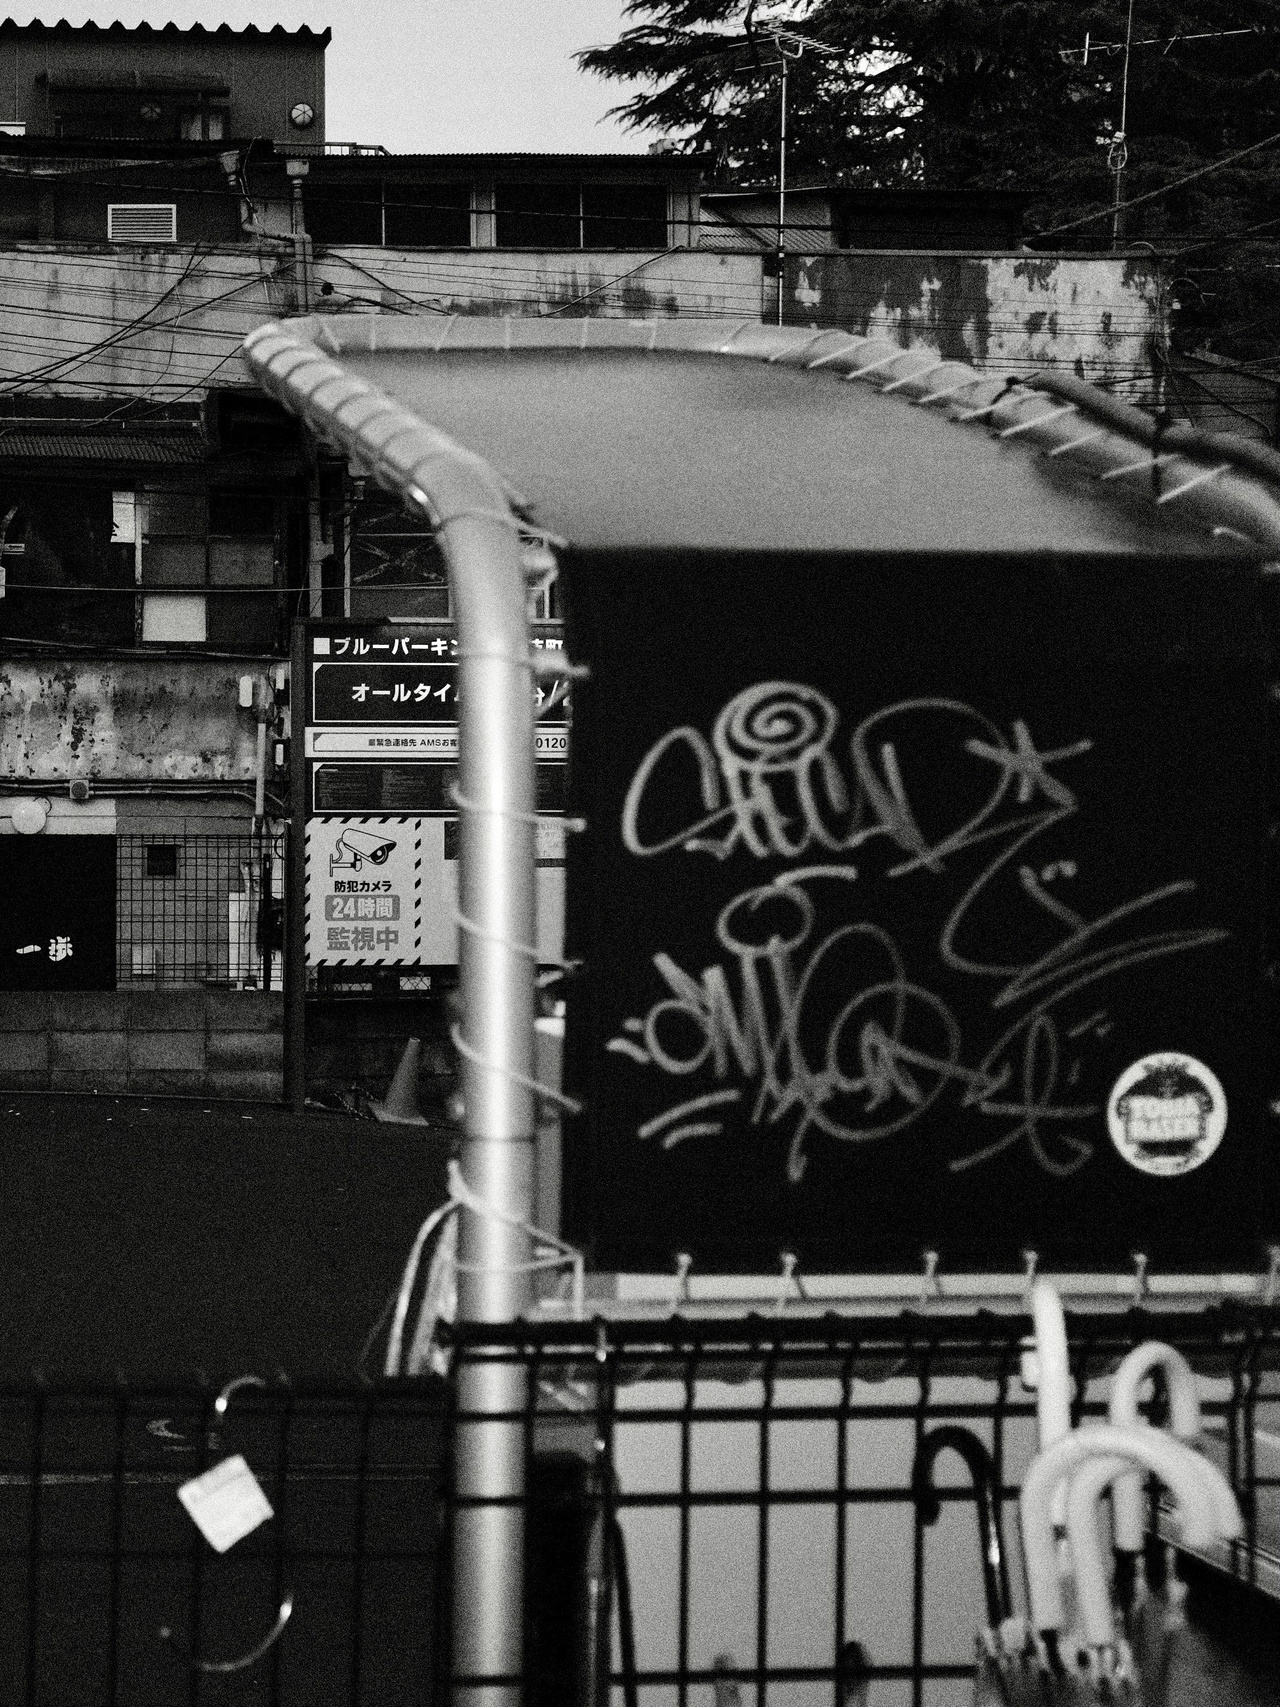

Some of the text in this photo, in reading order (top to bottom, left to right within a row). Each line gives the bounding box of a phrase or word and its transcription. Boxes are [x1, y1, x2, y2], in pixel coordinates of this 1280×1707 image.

[351, 683, 459, 702] オールタイ
[535, 737, 567, 749] 0120
[334, 880, 392, 893] 防犯カメラ
[332, 897, 394, 919] 24時間
[326, 926, 399, 952] 監視中
